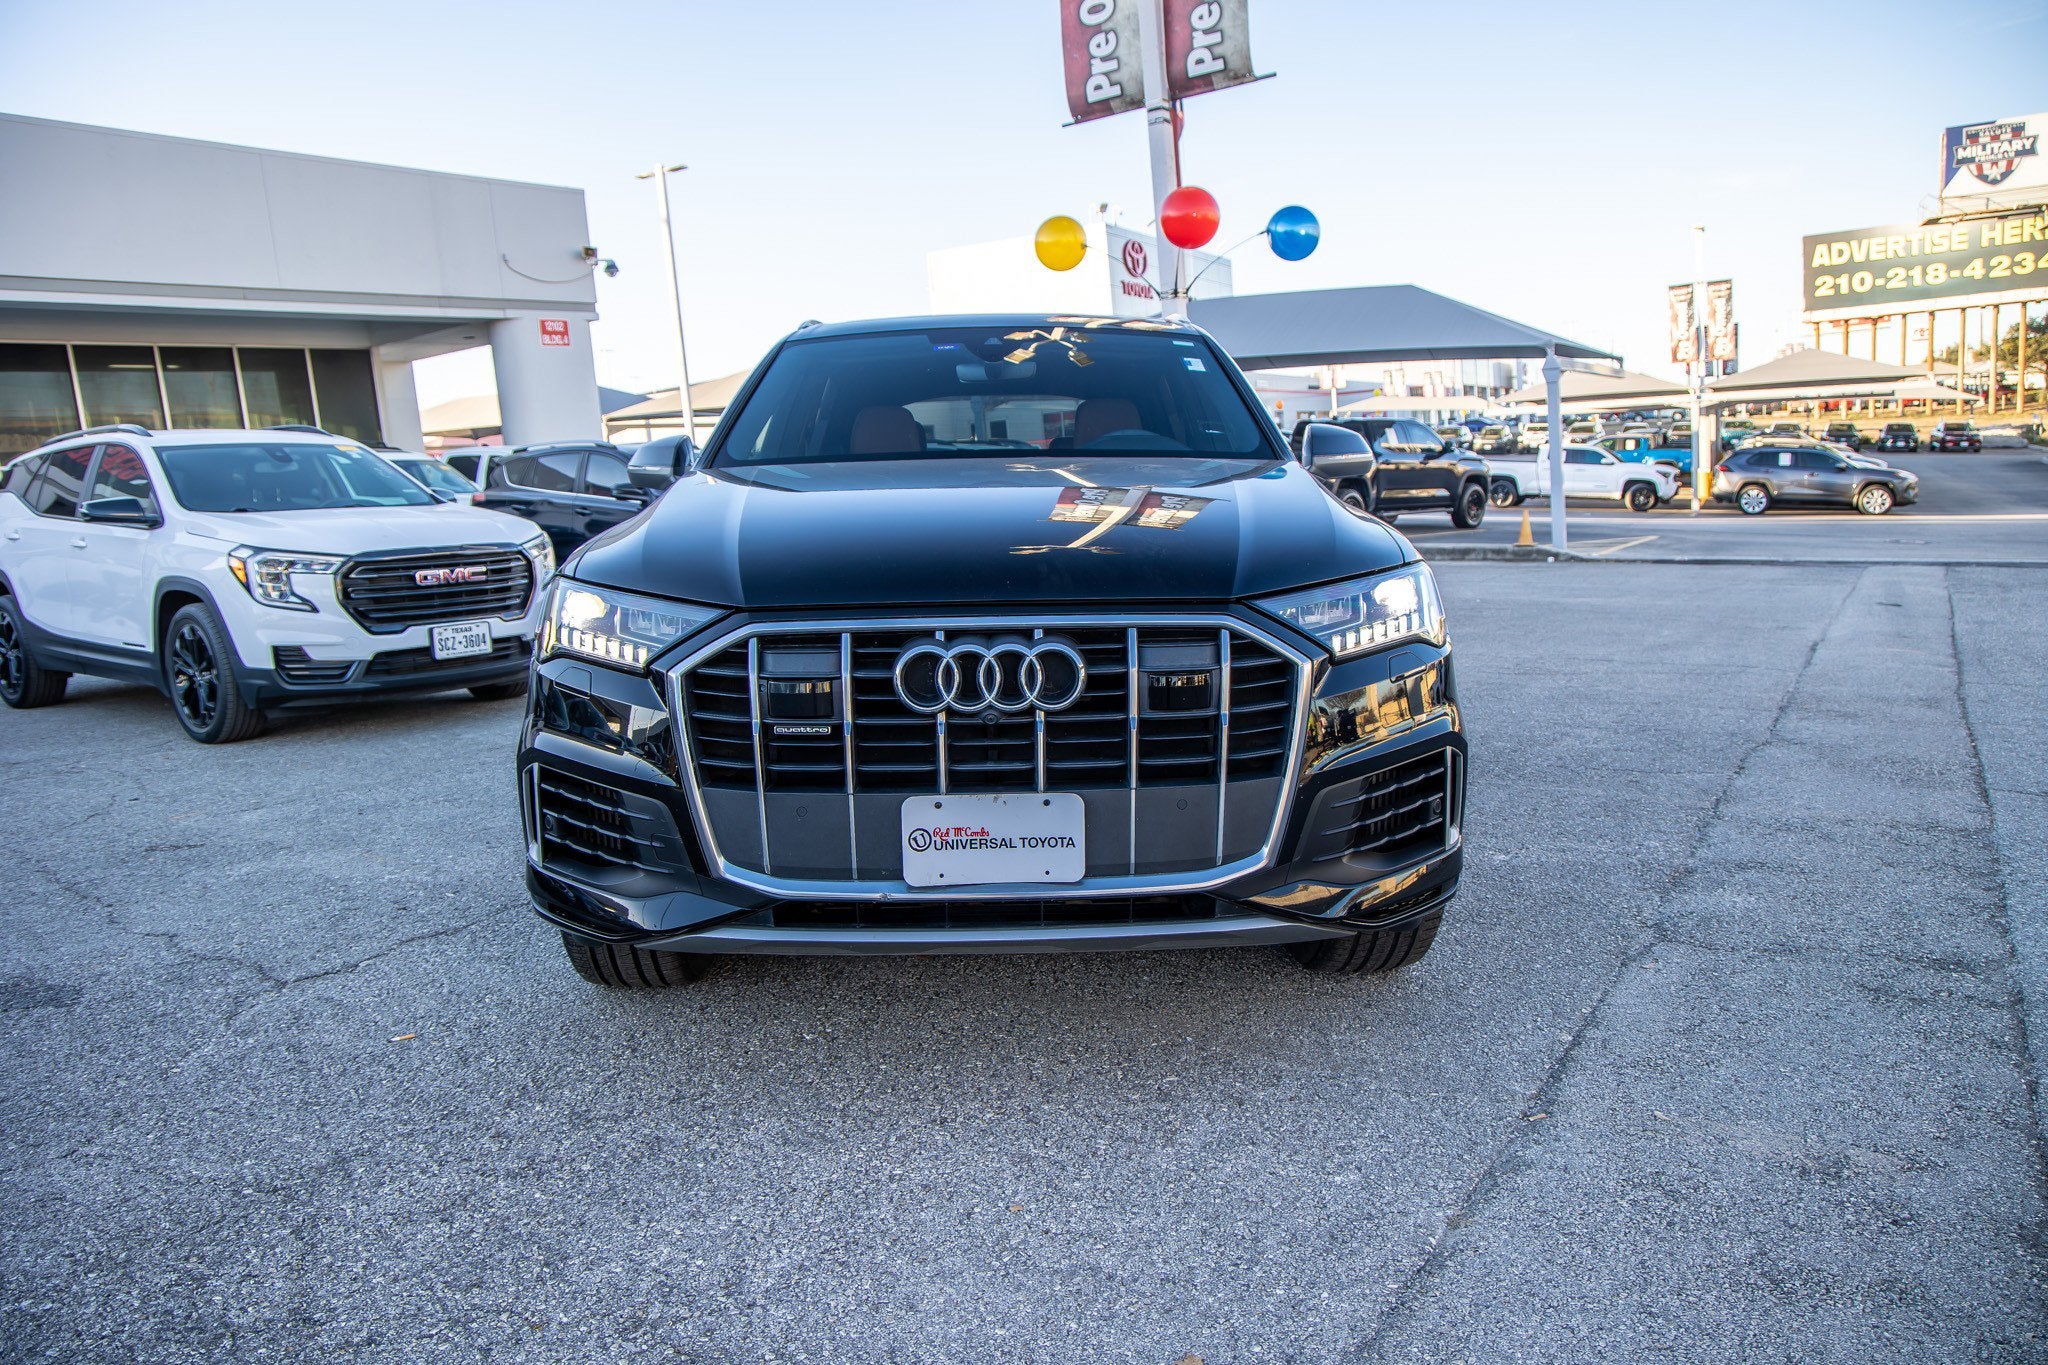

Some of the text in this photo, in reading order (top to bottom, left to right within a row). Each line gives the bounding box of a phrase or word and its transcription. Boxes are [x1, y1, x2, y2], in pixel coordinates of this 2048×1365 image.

[1186, 1, 1225, 79] Pre
[1085, 30, 1123, 104] Pre
[1957, 136, 2035, 160] MILITARY
[1812, 216, 2048, 268] ADVERTISE HER
[415, 566, 487, 586] GMC
[451, 626, 472, 634] TEXAS
[933, 827, 949, 841] Red
[934, 838, 1017, 850] UNIVERSAL
[1019, 837, 1076, 848] TOYOTA
